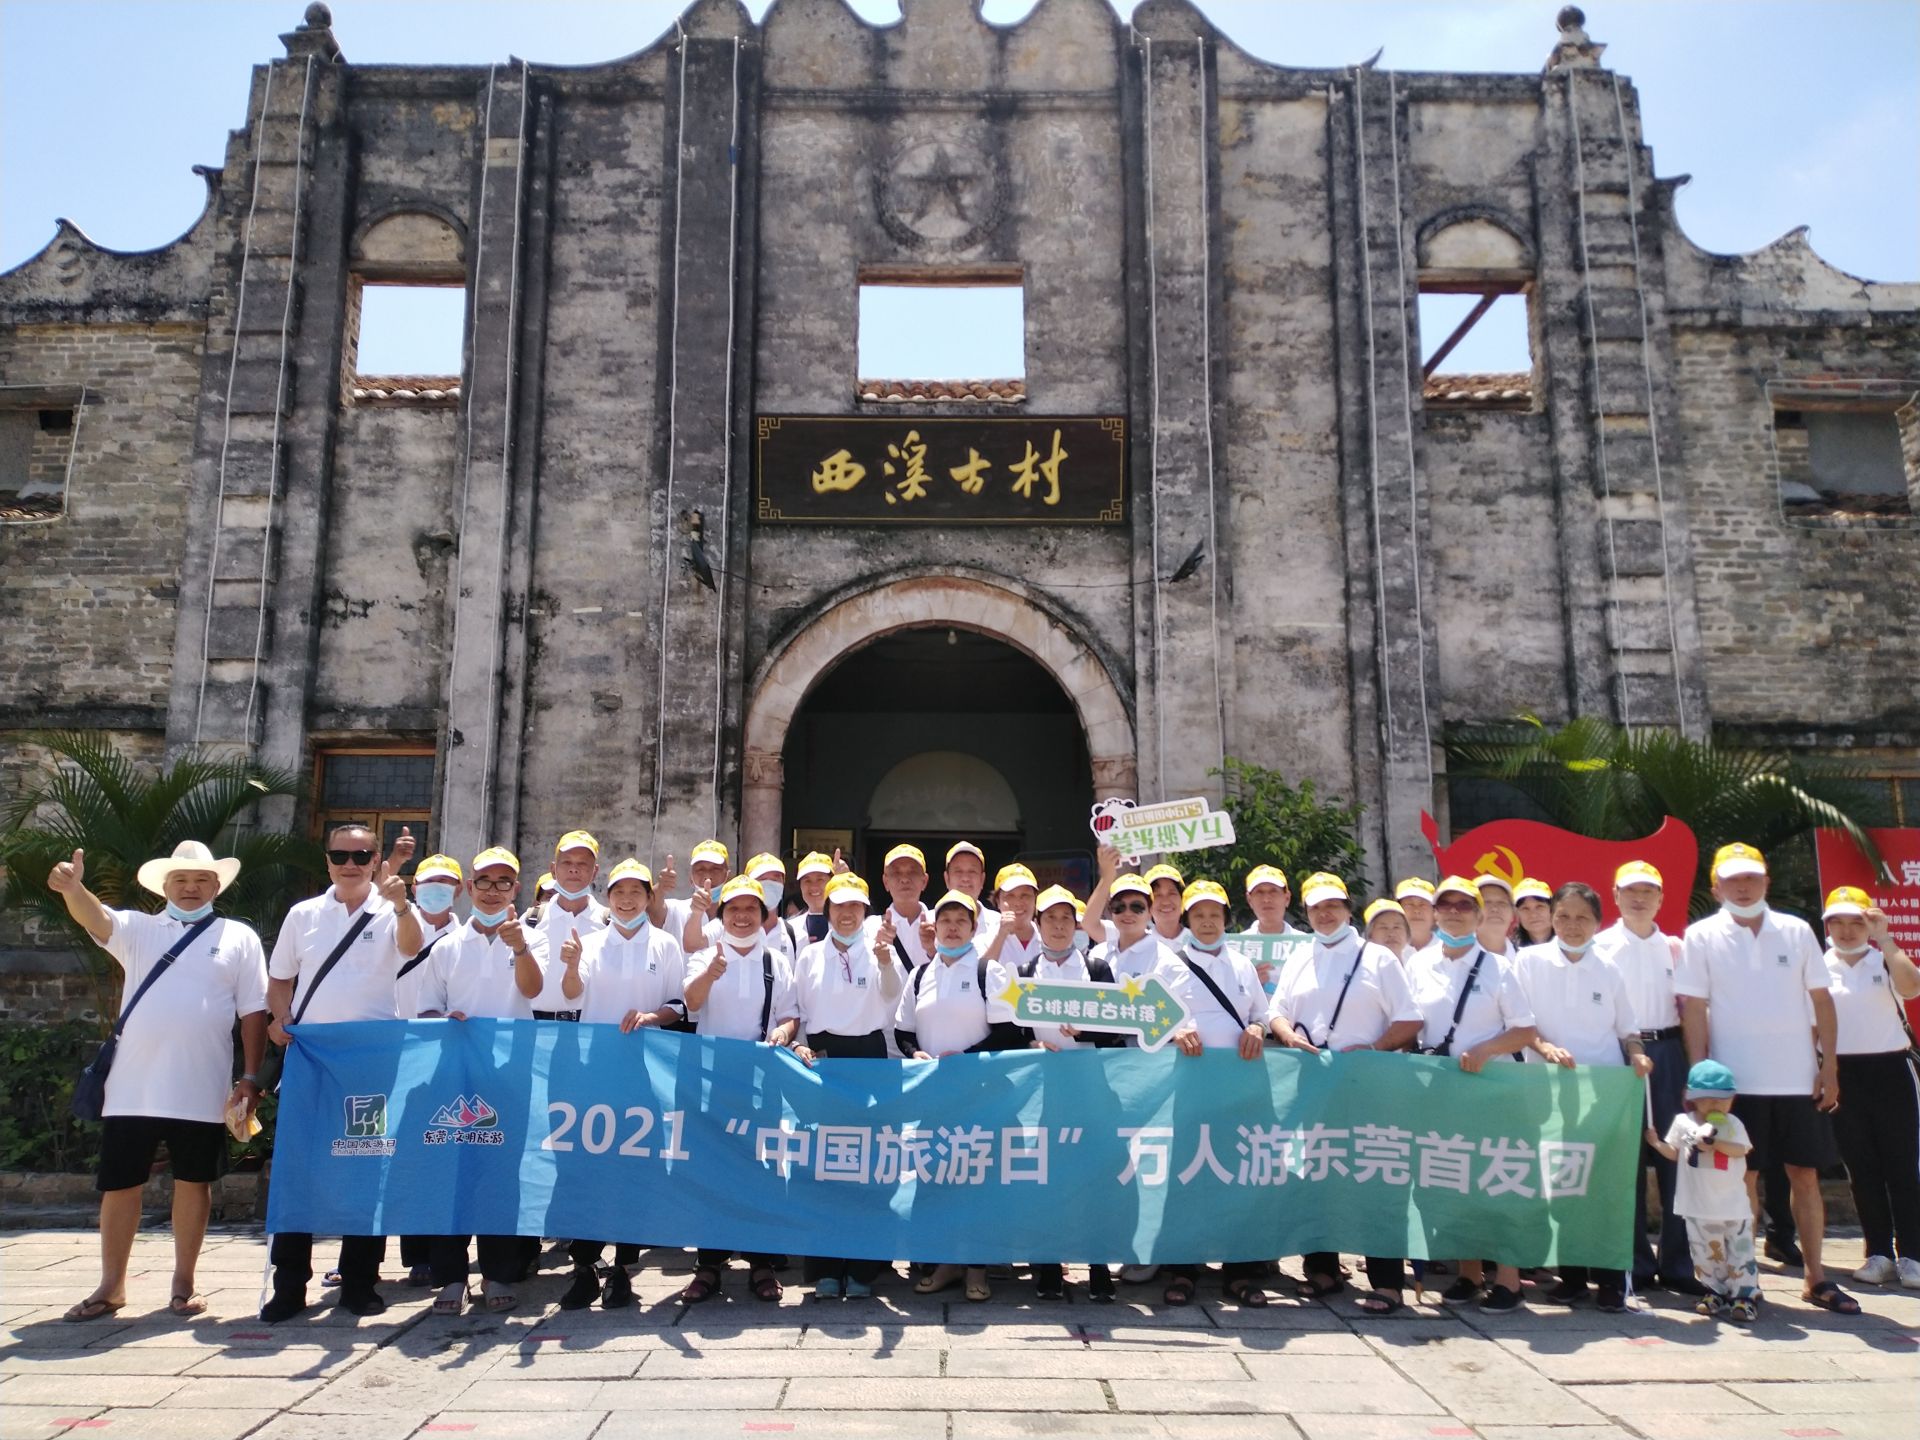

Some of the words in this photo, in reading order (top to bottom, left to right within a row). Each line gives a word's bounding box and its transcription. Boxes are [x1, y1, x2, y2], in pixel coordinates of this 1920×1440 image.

[811, 428, 1070, 505] 西溪古村
[1026, 996, 1157, 1023] 石排塘尾古村落
[331, 1138, 397, 1150] 中国旅游日
[331, 1148, 353, 1157] China
[354, 1148, 383, 1157] Tourism
[383, 1148, 396, 1157] Day
[541, 1101, 691, 1162] 2021
[1116, 1122, 1596, 1199] 万人游东莞首发团
